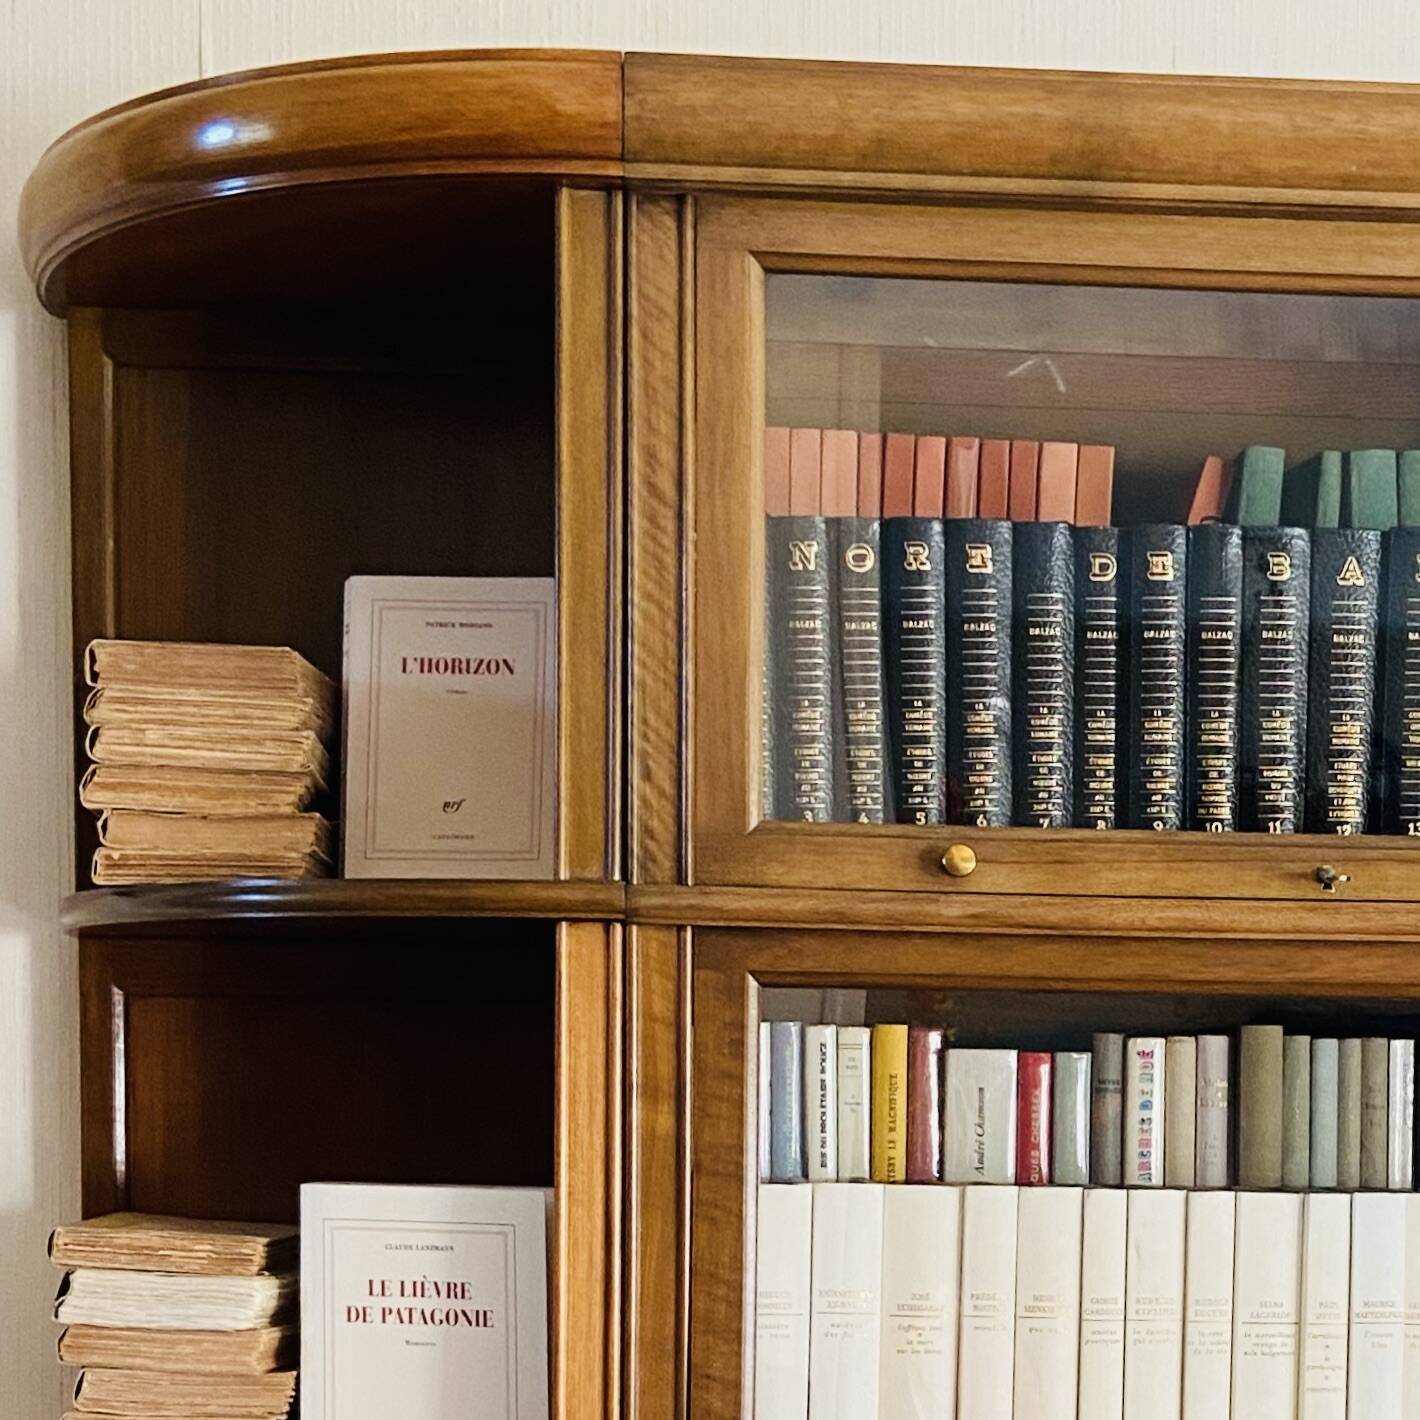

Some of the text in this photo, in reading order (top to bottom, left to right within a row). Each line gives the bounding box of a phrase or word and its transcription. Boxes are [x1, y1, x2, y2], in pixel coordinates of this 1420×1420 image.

[401, 656, 516, 676] L'HORIZON
[442, 798, 466, 814] nrf
[915, 812, 926, 825] 5
[977, 813, 988, 827] 6
[1039, 816, 1051, 830] 7
[973, 1140, 985, 1176] André
[368, 1274, 472, 1300] LE LIÈVRE
[346, 1306, 495, 1328] DE PATAGONIE
